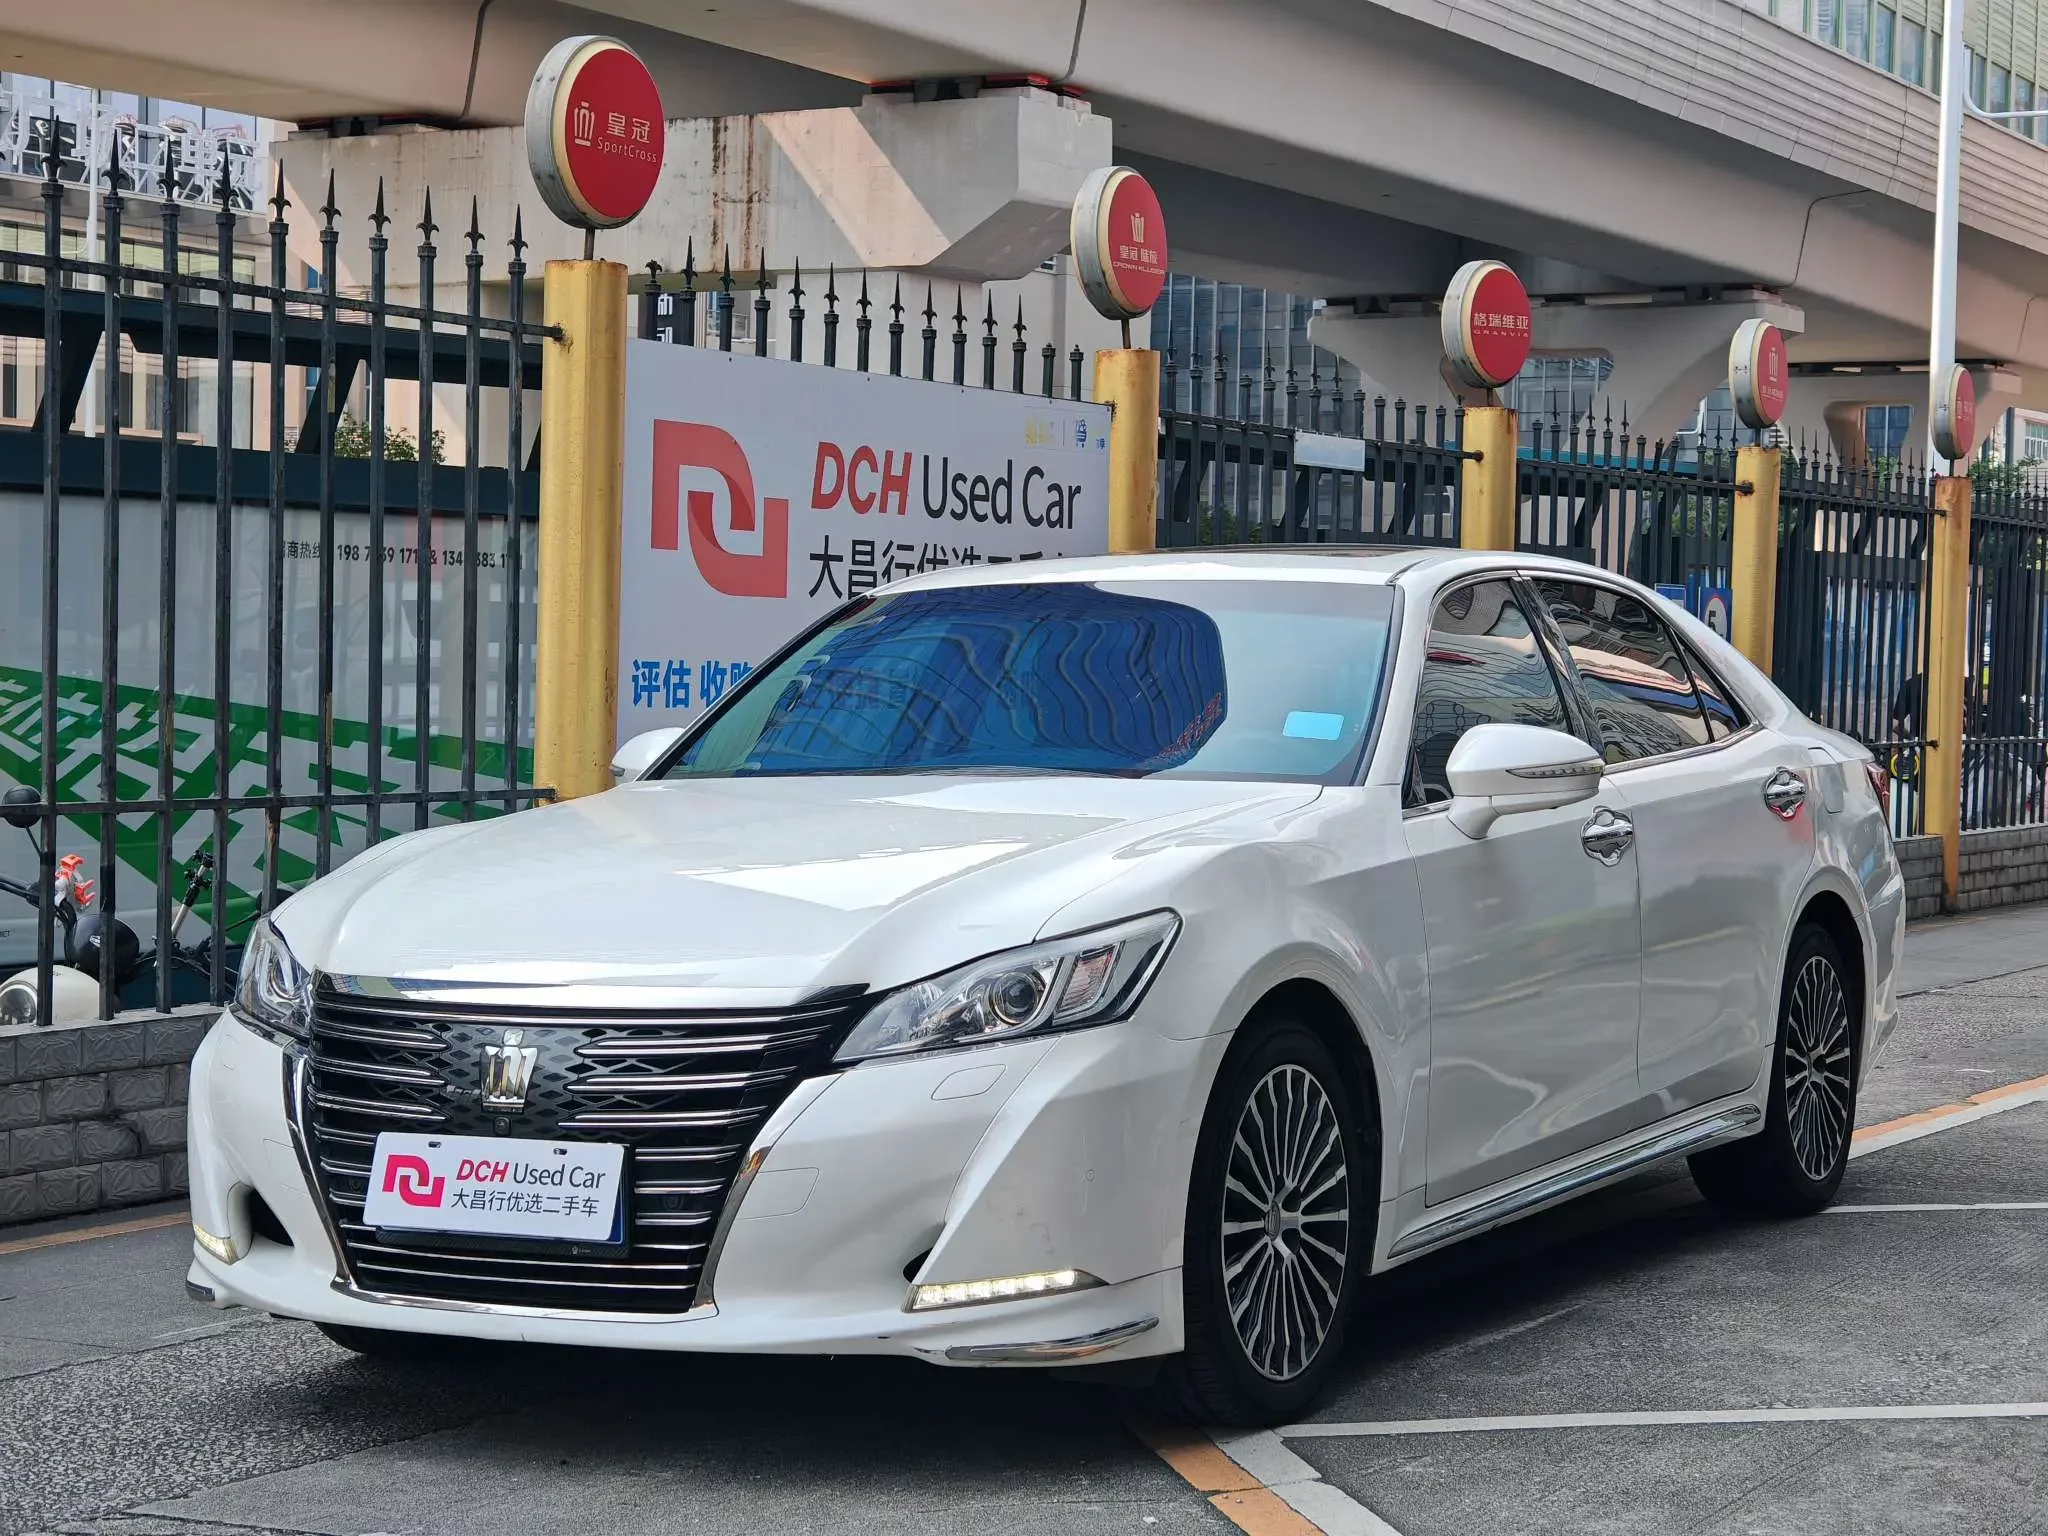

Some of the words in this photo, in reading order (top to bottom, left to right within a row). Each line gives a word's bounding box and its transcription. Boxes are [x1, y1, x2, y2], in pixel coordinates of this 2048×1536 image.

[606, 112, 651, 143] 皇冠
[597, 137, 657, 163] SportCross
[1473, 312, 1529, 330] 格瑞维亚
[1473, 329, 1529, 338] GRANVIA
[811, 441, 912, 516] DCH
[923, 454, 1012, 525] Used
[1022, 465, 1082, 530] Car
[337, 545, 360, 561] 198
[631, 659, 692, 709] 评估
[456, 1158, 510, 1183] DCH
[513, 1162, 566, 1187] Used
[569, 1165, 607, 1189] Car
[450, 1187, 600, 1218] 大昌行优选二手车
